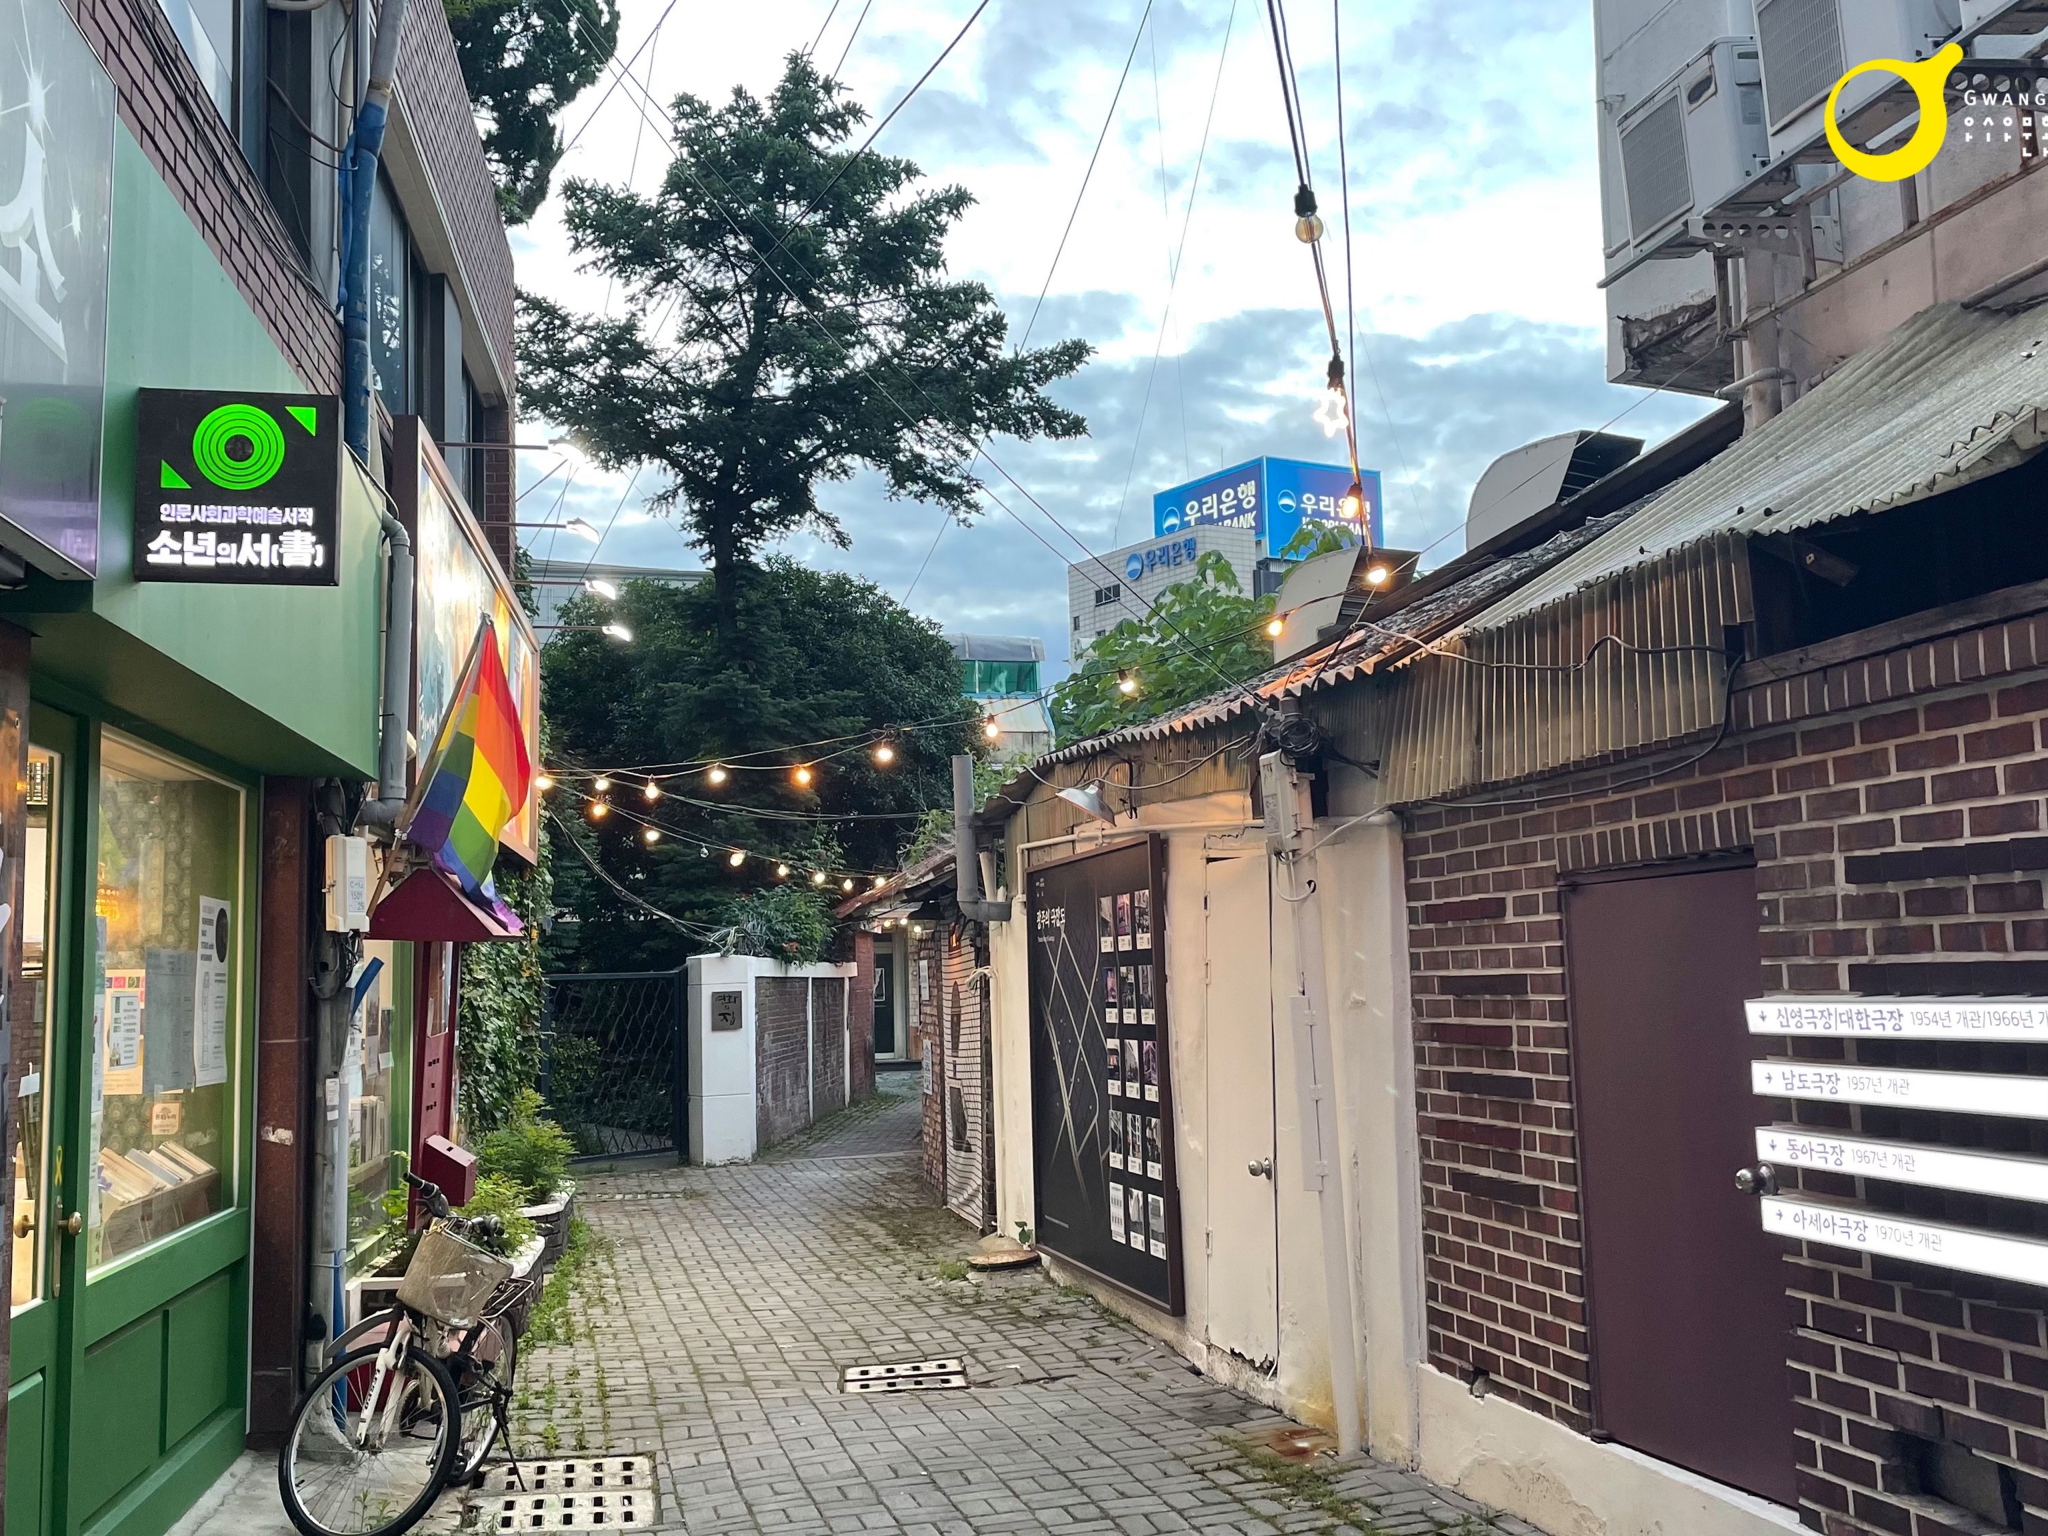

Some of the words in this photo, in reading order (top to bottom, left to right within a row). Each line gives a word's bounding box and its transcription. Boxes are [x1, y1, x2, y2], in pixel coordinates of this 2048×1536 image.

[160, 503, 314, 526] 인문사회과학예술서적
[1184, 480, 1256, 527] 우리은행
[1300, 493, 1370, 520] 우리
[1144, 537, 1197, 573] 우리은행
[1910, 1010, 1952, 1028] 1954년
[1782, 1069, 1841, 1095] 남도극장
[1847, 1076, 1882, 1094] 1957년
[1887, 1078, 1910, 1096] 개관
[1787, 1138, 1845, 1167] 동아극장
[1851, 1148, 1888, 1169] 1967년
[1892, 1153, 1916, 1173] 개관
[1793, 1209, 1869, 1243] 아세아극장
[1875, 1224, 1914, 1247] 1970년
[1918, 1232, 1942, 1252] 개관
